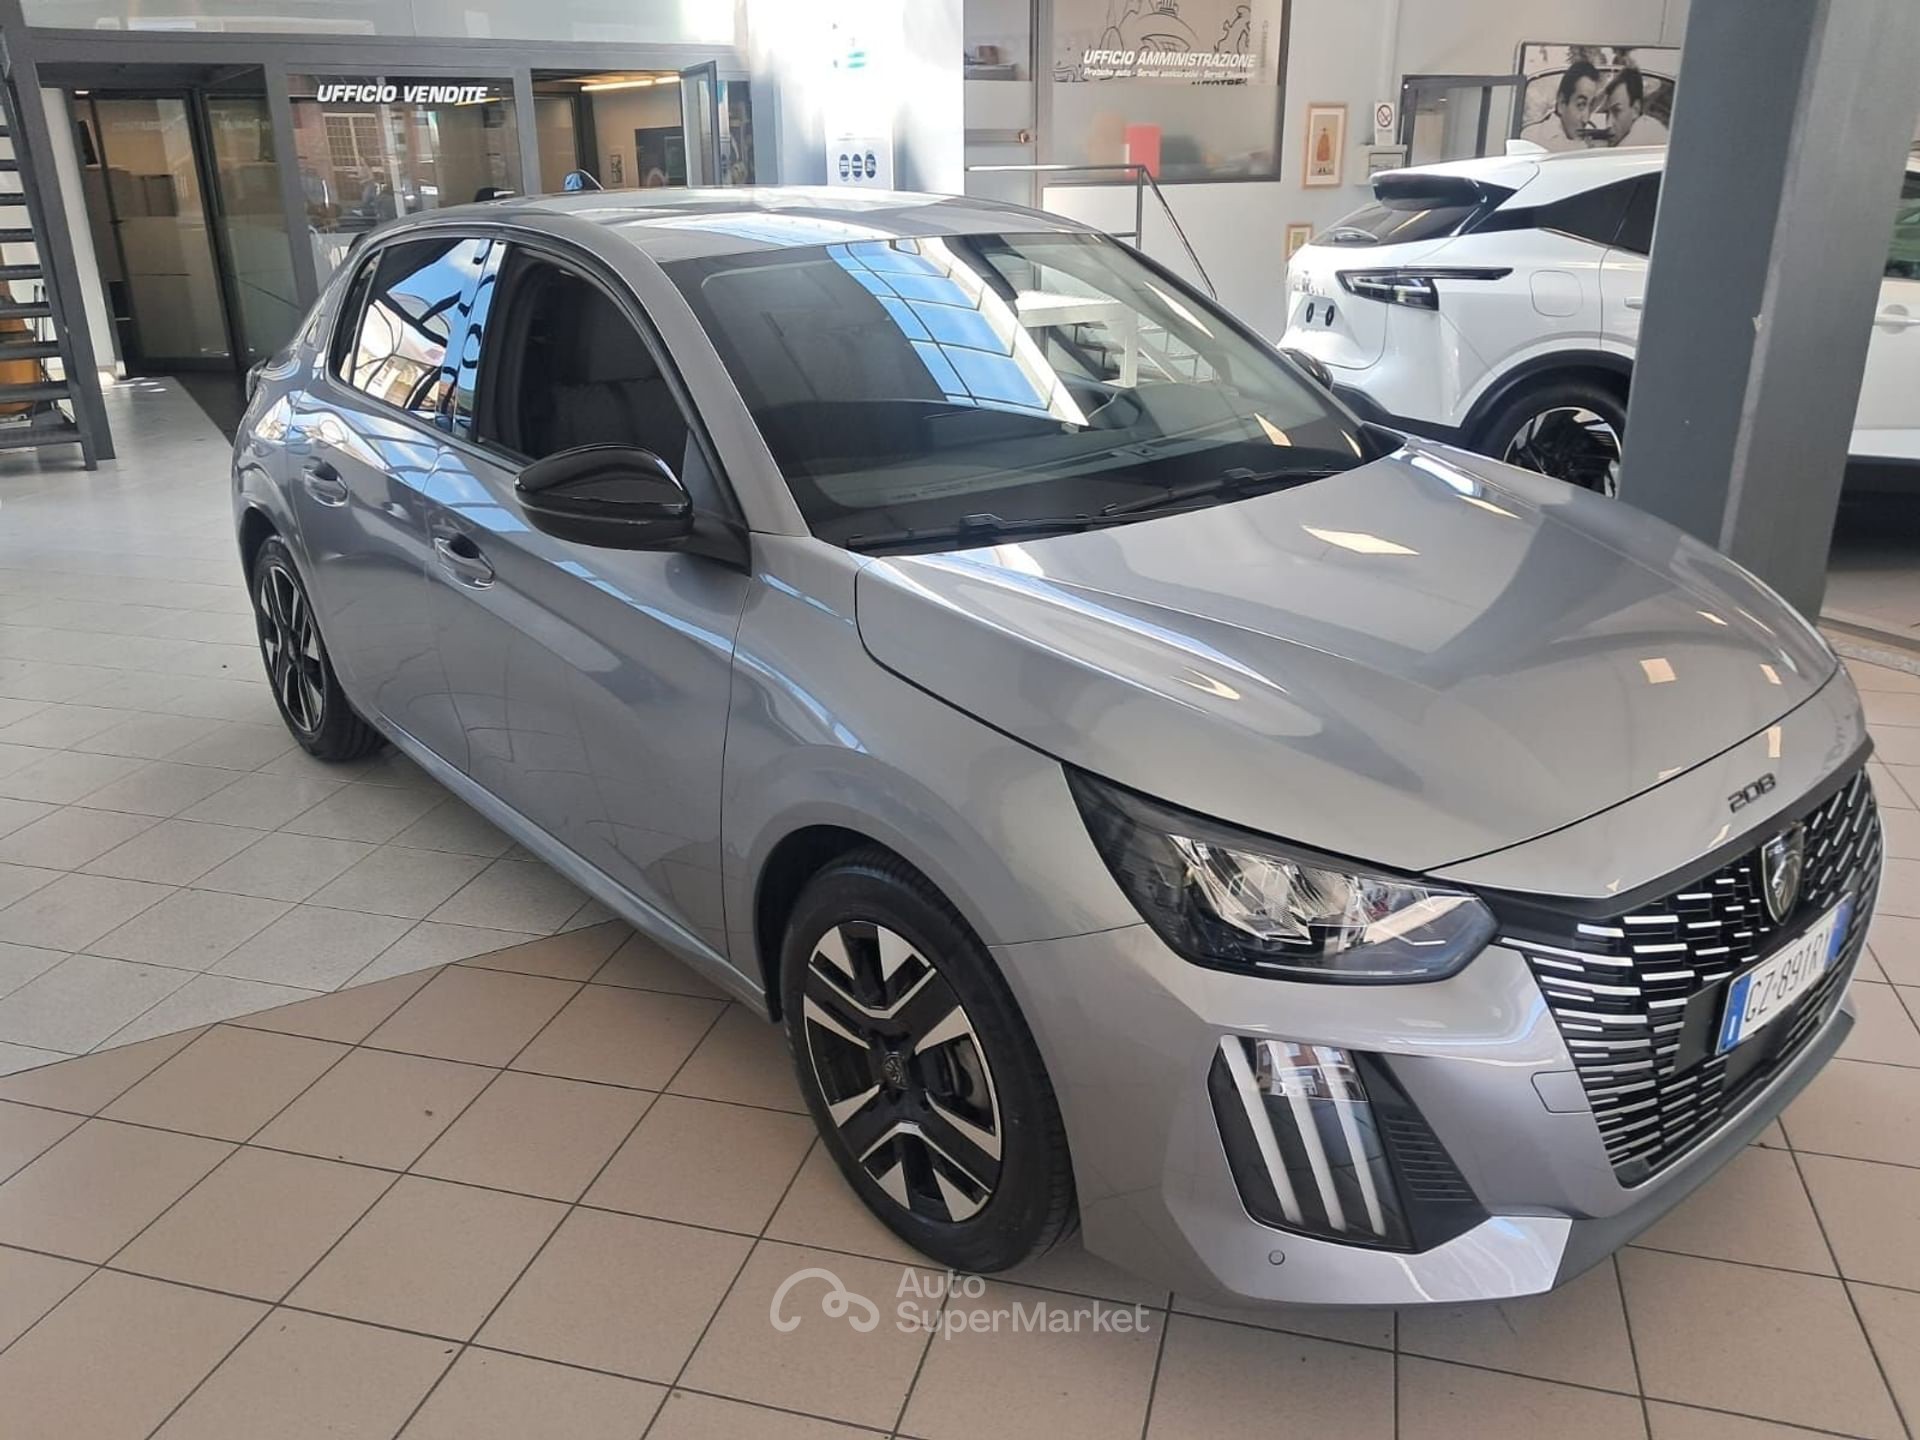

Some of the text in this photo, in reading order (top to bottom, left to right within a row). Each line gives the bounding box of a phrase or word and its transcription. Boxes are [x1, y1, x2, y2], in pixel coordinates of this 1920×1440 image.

[1083, 50, 1256, 68] UFFICIO AMMINISTRAZIONE
[317, 84, 488, 104] UFFICIO VENDITE
[1728, 773, 1776, 813] 208
